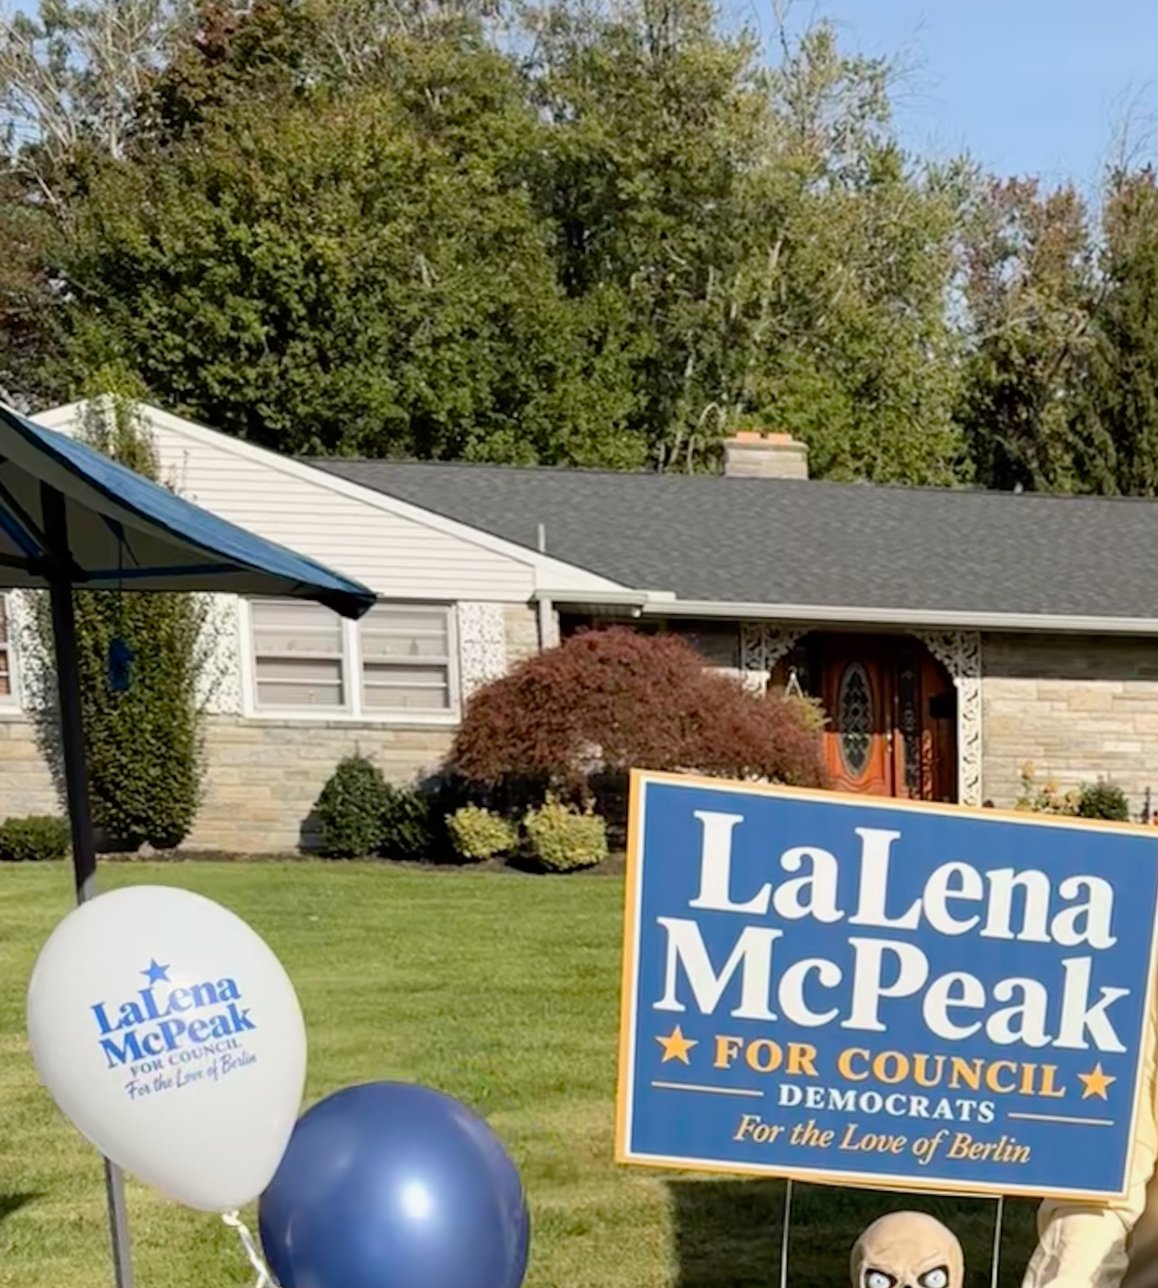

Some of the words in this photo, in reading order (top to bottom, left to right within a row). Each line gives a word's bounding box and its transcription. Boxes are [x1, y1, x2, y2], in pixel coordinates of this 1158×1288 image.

[689, 810, 1117, 949] LaLena
[90, 978, 242, 1034] LaLena
[652, 916, 1130, 1053] McPeak
[99, 1002, 256, 1069] McPeak
[130, 1059, 163, 1077] FOR
[168, 1038, 242, 1066] COUNCIL
[125, 1079, 151, 1100] For
[154, 1073, 173, 1092] the
[177, 1067, 203, 1088] Love
[207, 1059, 218, 1082] of
[220, 1050, 257, 1075] Berlin
[714, 1035, 819, 1076] FOR
[838, 1047, 1066, 1097] COUNCIL
[778, 1084, 996, 1123] DEMOCRATS
[734, 1114, 785, 1142] For
[791, 1119, 834, 1147] the
[840, 1123, 907, 1154] Love
[912, 1129, 950, 1165] of
[949, 1132, 1032, 1164] Berlin
